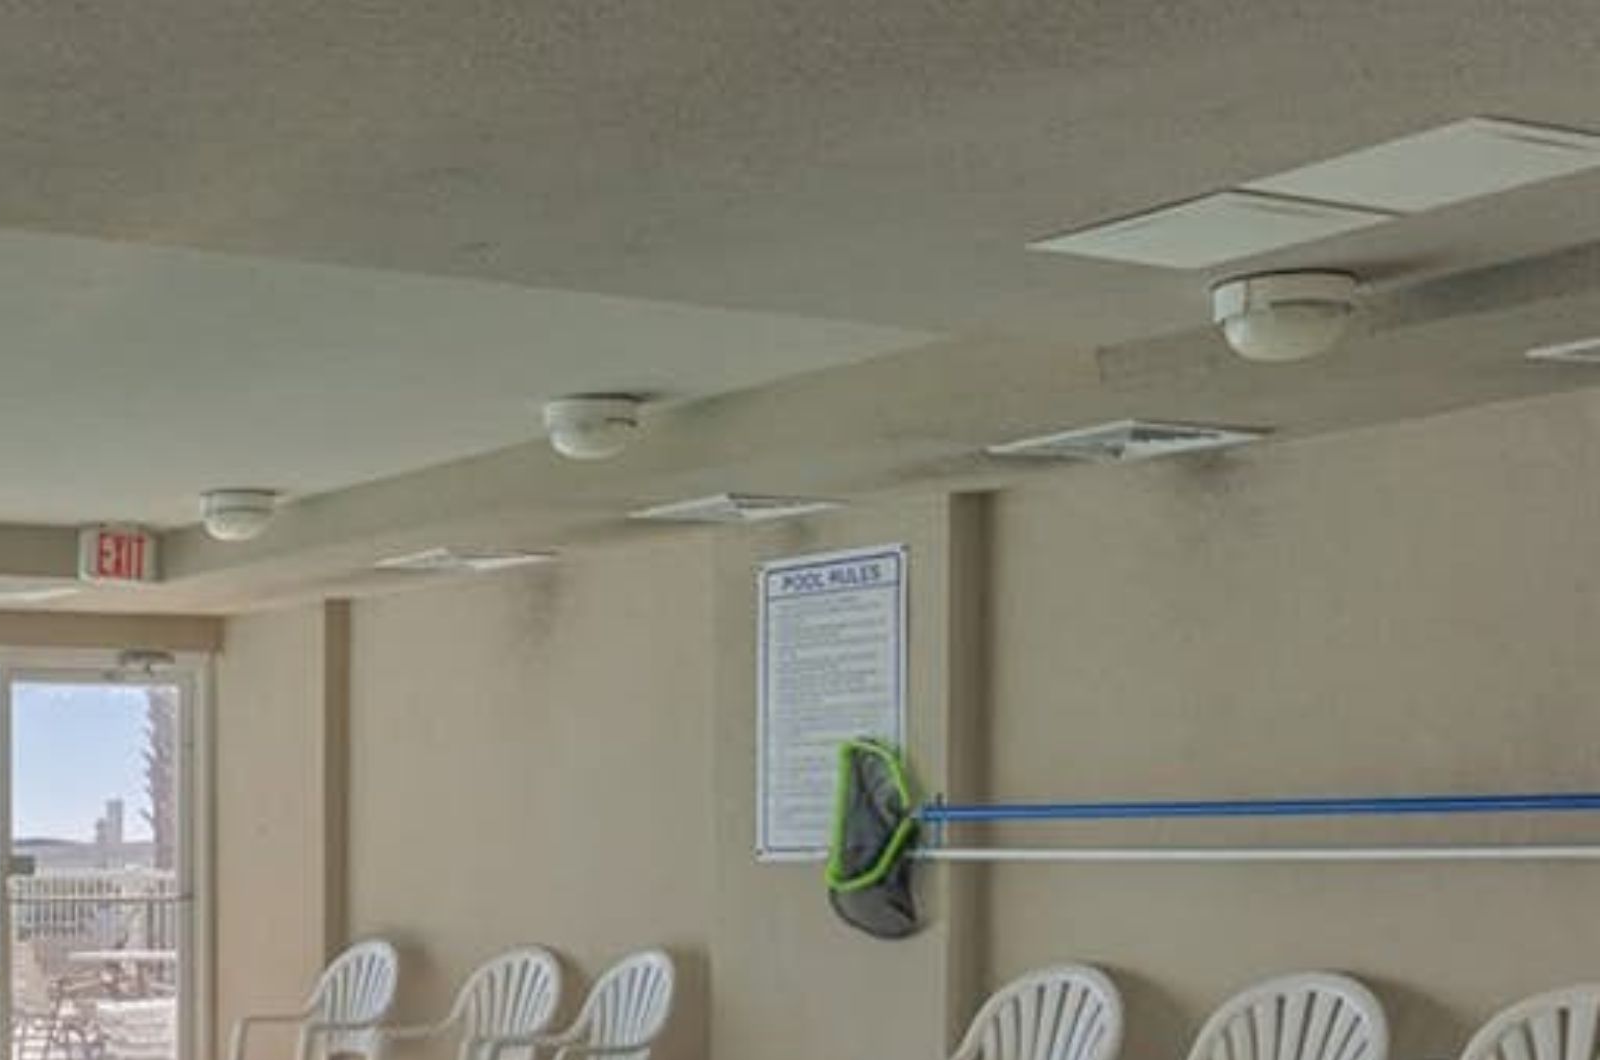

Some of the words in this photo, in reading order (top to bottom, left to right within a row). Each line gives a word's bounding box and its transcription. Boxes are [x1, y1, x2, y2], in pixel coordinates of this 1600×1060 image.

[97, 532, 145, 579] EXIT
[781, 572, 825, 591] POOL
[828, 564, 882, 583] RULES
